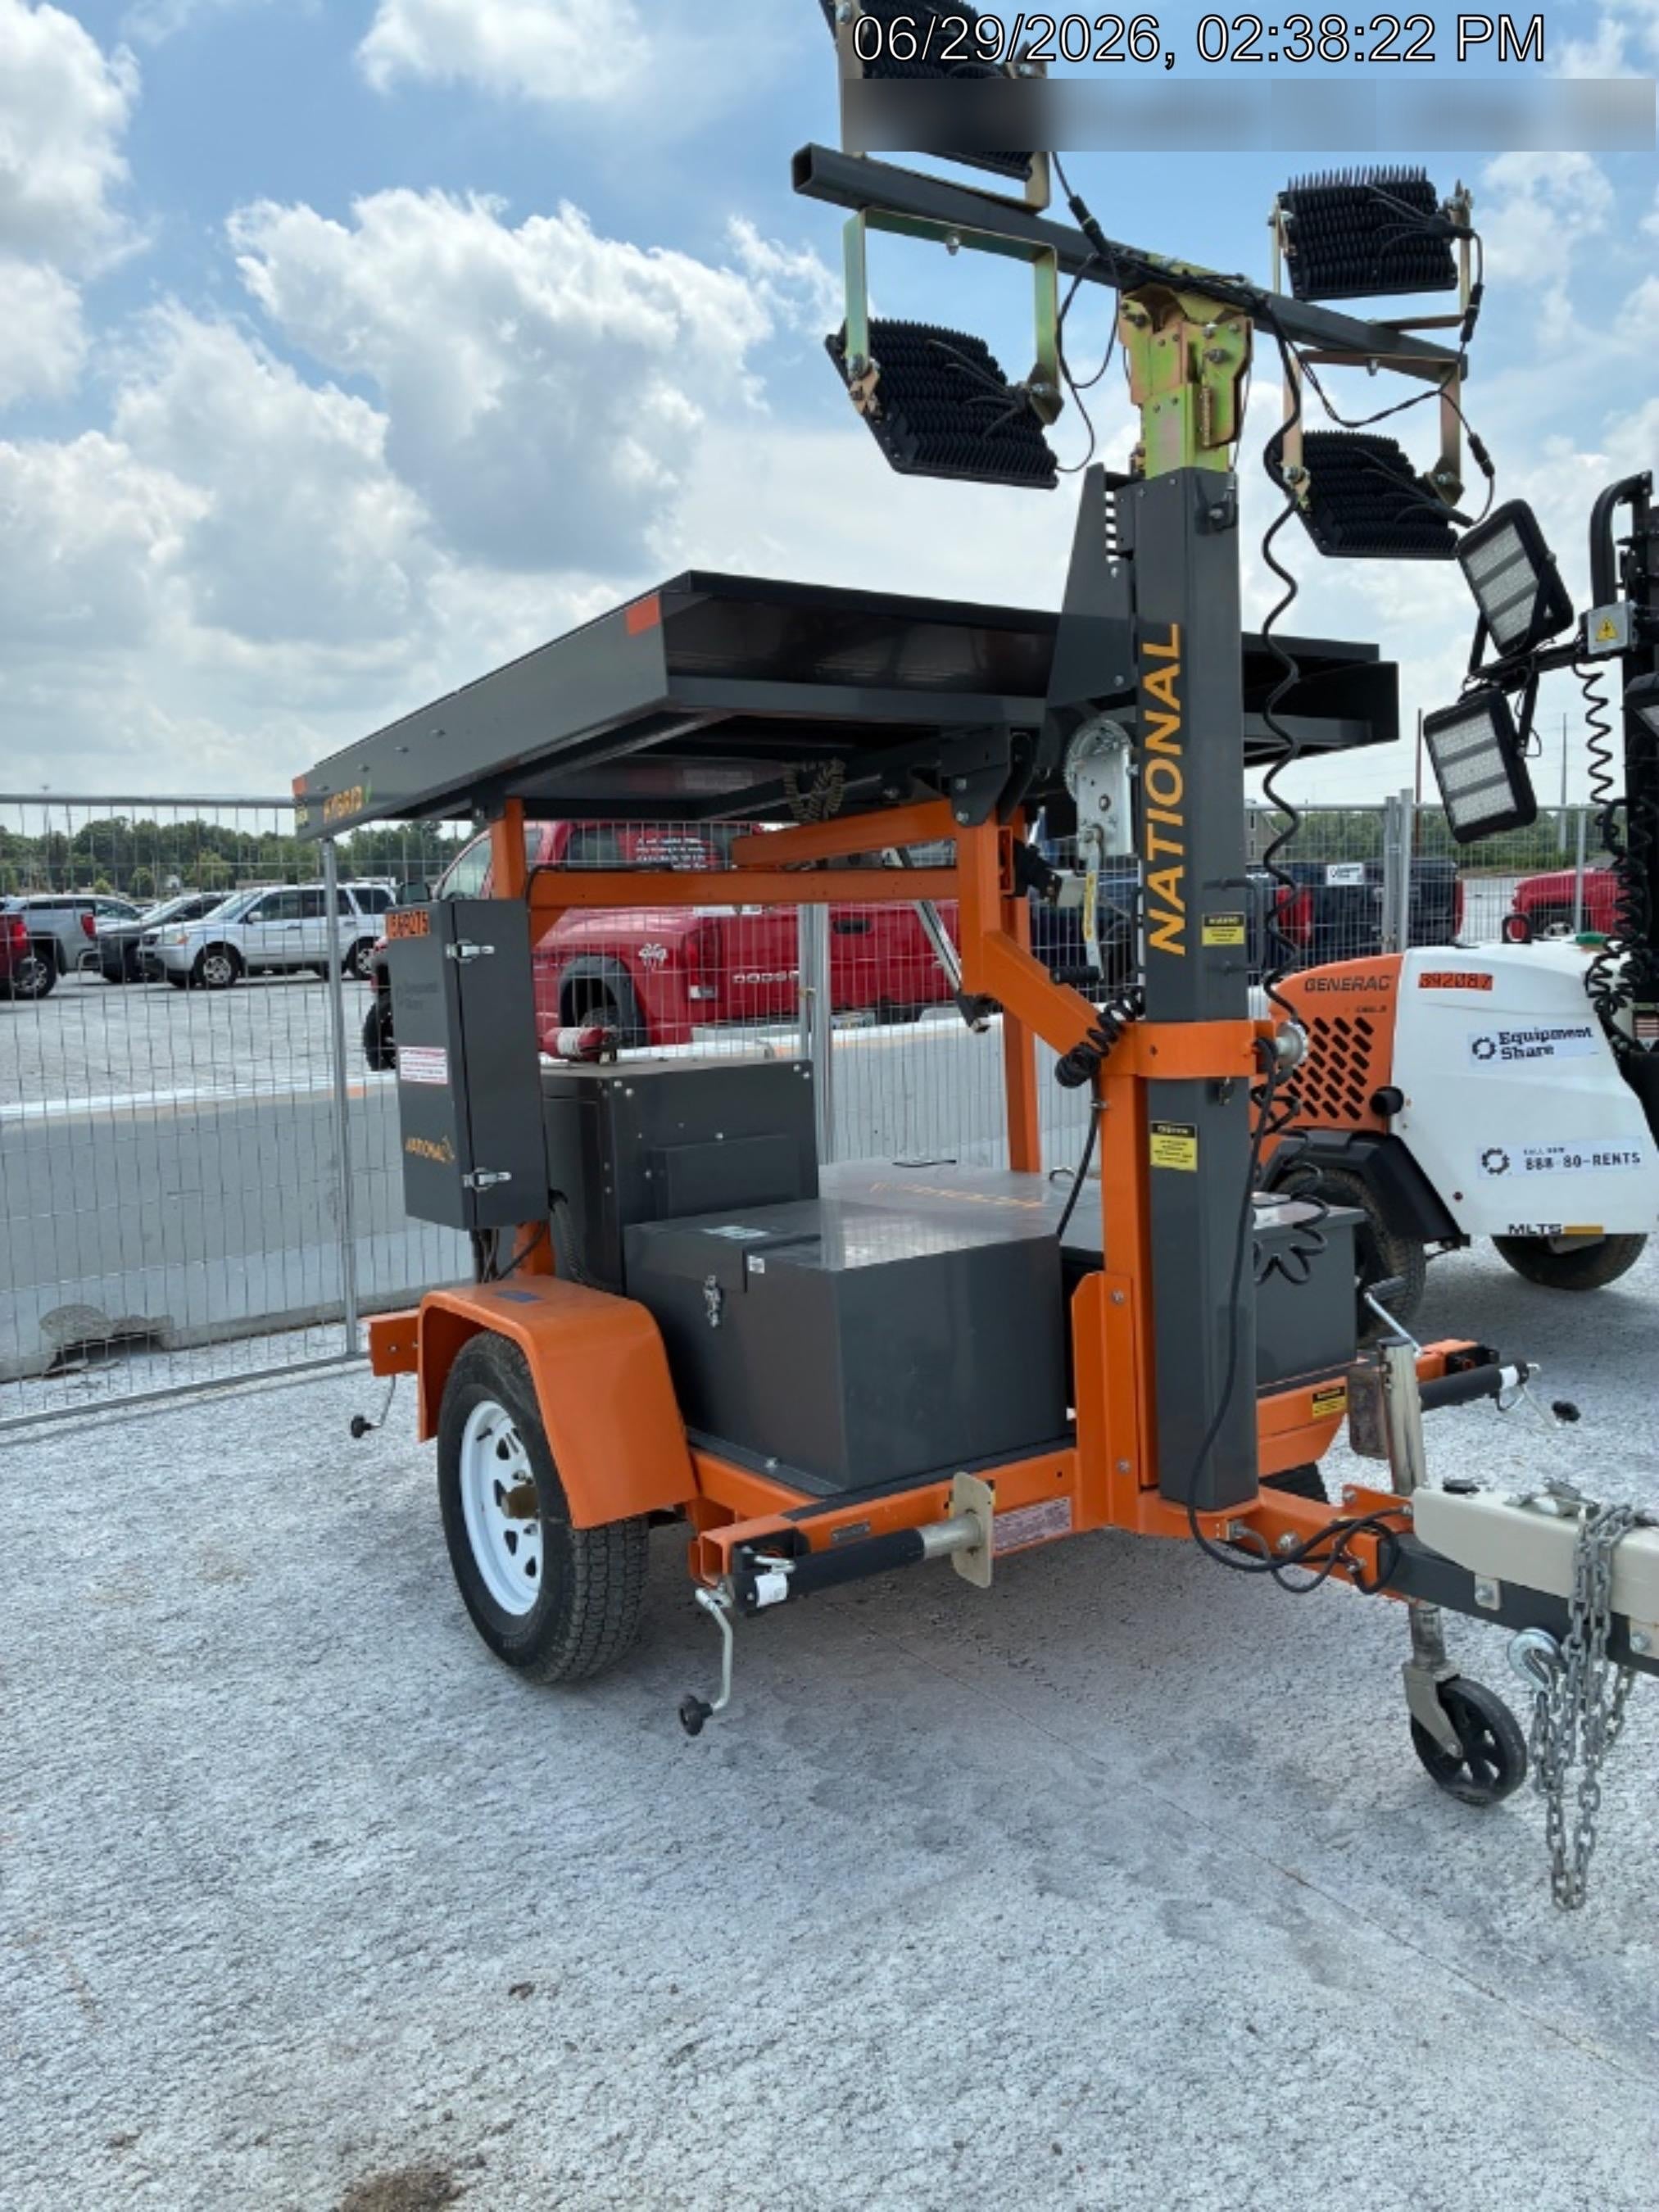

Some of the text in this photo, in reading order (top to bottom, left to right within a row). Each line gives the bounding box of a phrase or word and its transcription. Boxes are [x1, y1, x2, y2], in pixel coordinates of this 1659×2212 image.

[1142, 623, 1185, 956] NATIONAL
[1304, 975, 1392, 993] GENERAC
[1498, 1027, 1593, 1045] Equipment
[1501, 1045, 1555, 1061] Share
